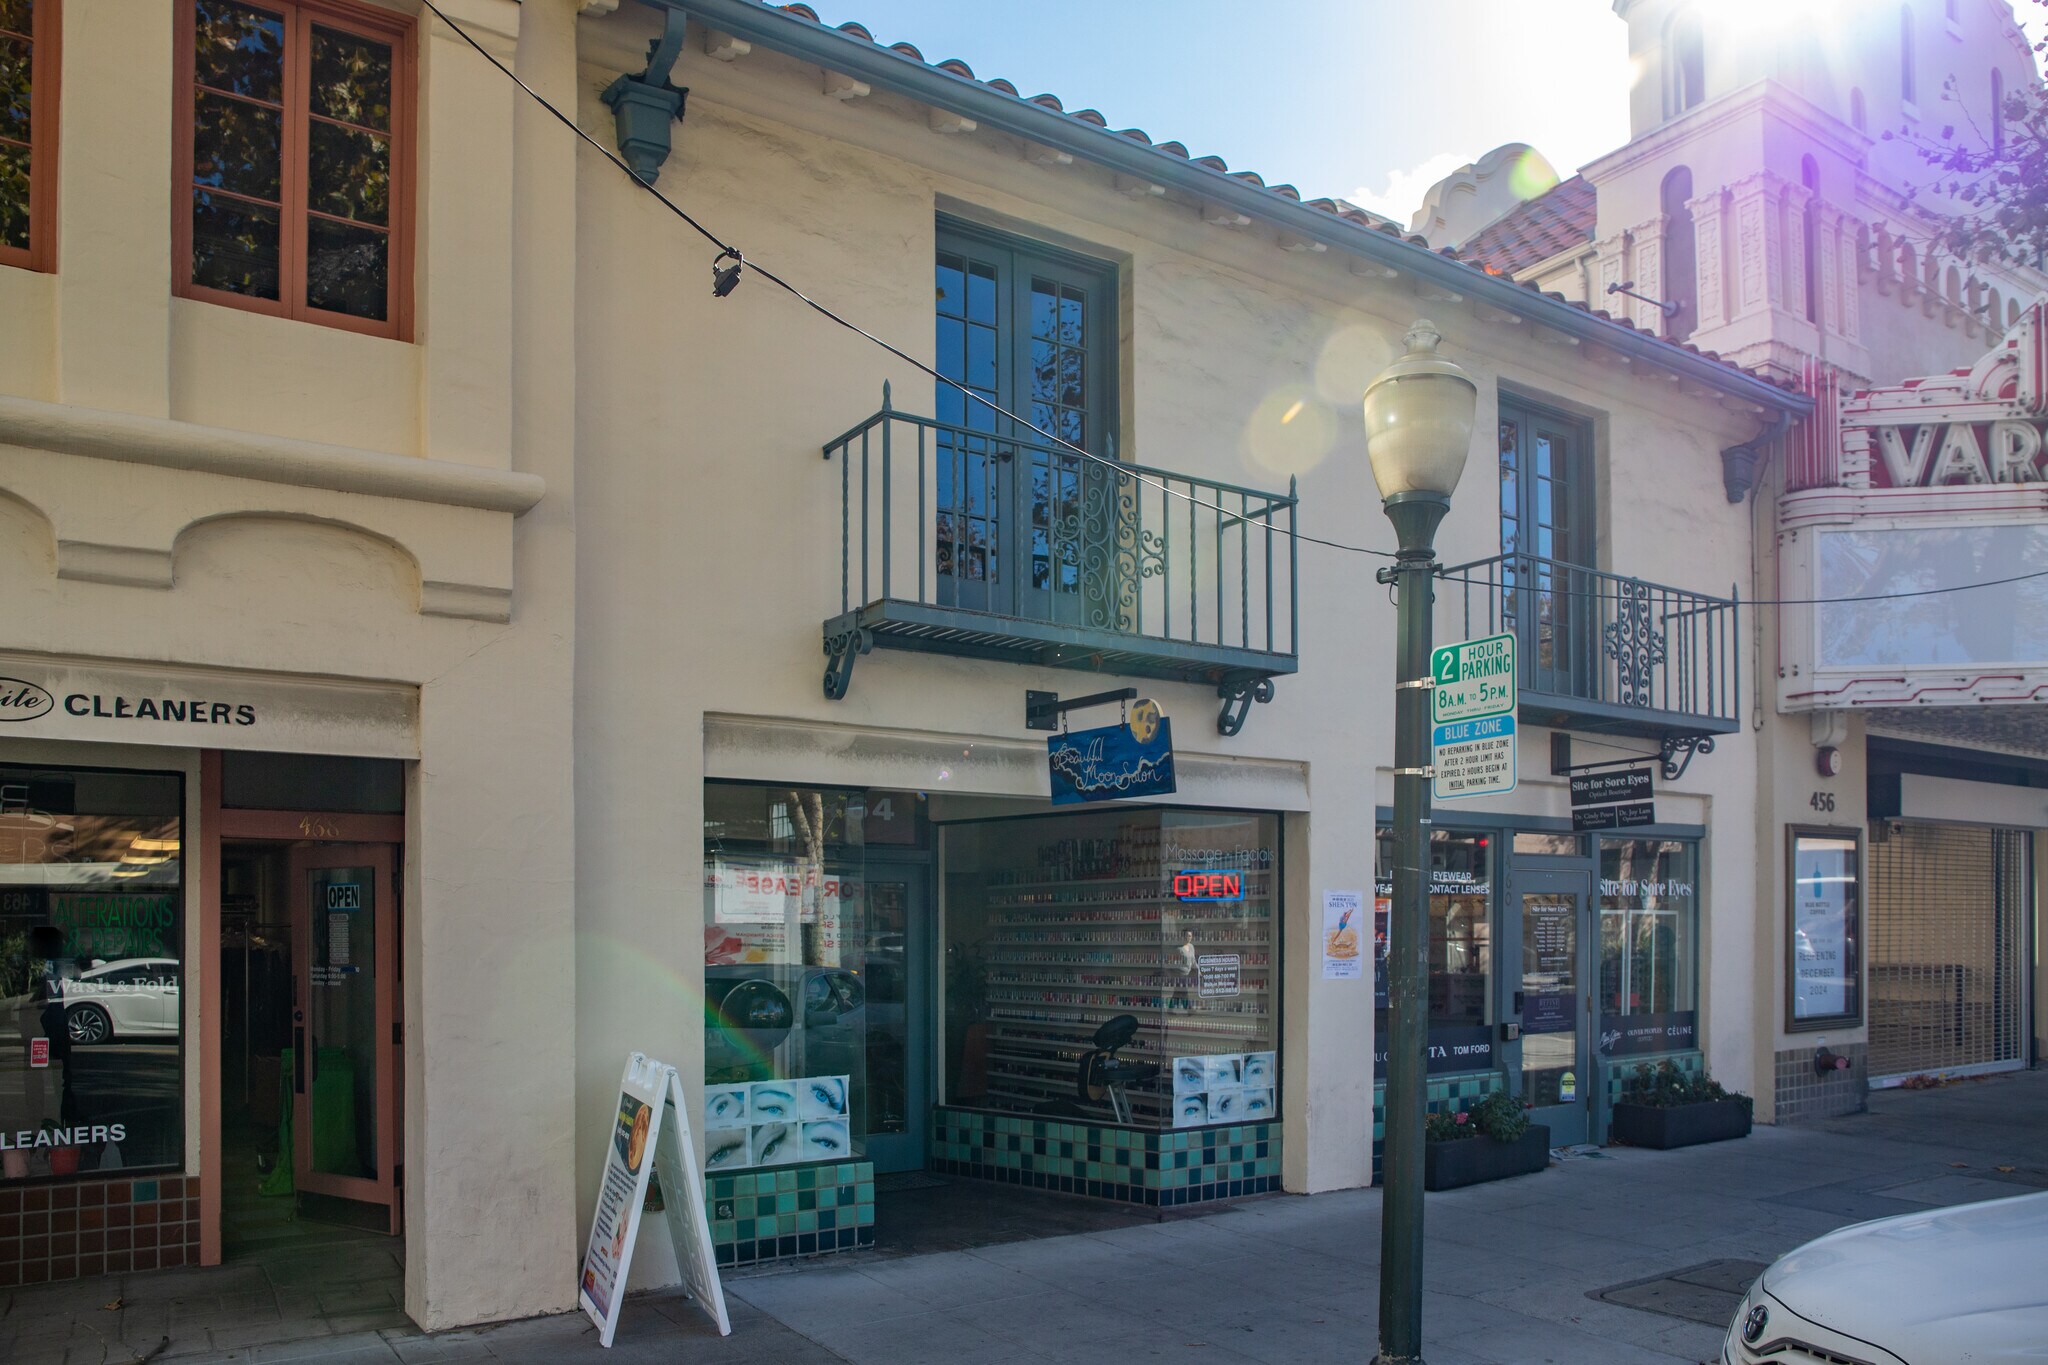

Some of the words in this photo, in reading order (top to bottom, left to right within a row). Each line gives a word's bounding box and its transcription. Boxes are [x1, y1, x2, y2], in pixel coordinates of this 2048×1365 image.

[1876, 421, 2048, 487] VAR
[1441, 651, 1454, 680] 2
[1468, 642, 1503, 660] HOUR
[1462, 654, 1510, 681] PARKING
[64, 694, 256, 726] CLEANERS
[1445, 724, 1469, 740] BLUE
[1474, 719, 1502, 735] ZONE
[1053, 737, 1105, 770] Beautiful
[1447, 745, 1473, 755] REPARKING
[1475, 743, 1480, 751] IN
[1482, 742, 1494, 750] BLUE
[1496, 739, 1509, 748] ZONE
[1444, 758, 1458, 767] AFTER
[1460, 757, 1464, 765] 2
[1465, 755, 1479, 763] HOUR
[1480, 753, 1493, 762] LIMIT
[1462, 768, 1466, 776] 2
[1467, 766, 1483, 775] HOURS
[1485, 764, 1500, 773] BEGIN
[1076, 764, 1116, 790] Moon
[1115, 761, 1163, 790] Salon
[1449, 780, 1465, 789] INITIAL
[1466, 777, 1487, 787] PARKING
[1488, 775, 1501, 784] TIME.
[1572, 781, 1589, 791] Site
[1590, 779, 1604, 789] for
[1604, 777, 1627, 788] Sore
[1627, 774, 1650, 787] Eyes
[1588, 791, 1608, 799] Optical
[1608, 788, 1632, 796] Boutique
[1810, 791, 1835, 812] 456
[299, 815, 340, 837] 468
[1165, 843, 1222, 863] Massage
[1235, 844, 1275, 862] Facials
[1173, 875, 1239, 896] OPEN
[1433, 871, 1472, 881] EYEWEAR
[329, 887, 358, 907] OPEN
[1429, 885, 1460, 894] ONTACT
[1461, 884, 1490, 894] LENSES
[1621, 878, 1638, 896] for
[1640, 878, 1666, 897] Sore
[1668, 878, 1692, 901] Eyes
[56, 895, 174, 928] ALTERATIONS
[64, 928, 86, 958] &
[92, 927, 165, 957] REPAIRS
[1800, 968, 1835, 978] DECEMBER
[48, 978, 110, 995] Wash
[117, 978, 130, 992] &
[132, 975, 178, 993] Fold
[1809, 986, 1828, 996] 2024
[1667, 1025, 1692, 1036] CÉLINE
[1453, 1046, 1469, 1055] TOM
[1470, 1044, 1490, 1054] FORD
